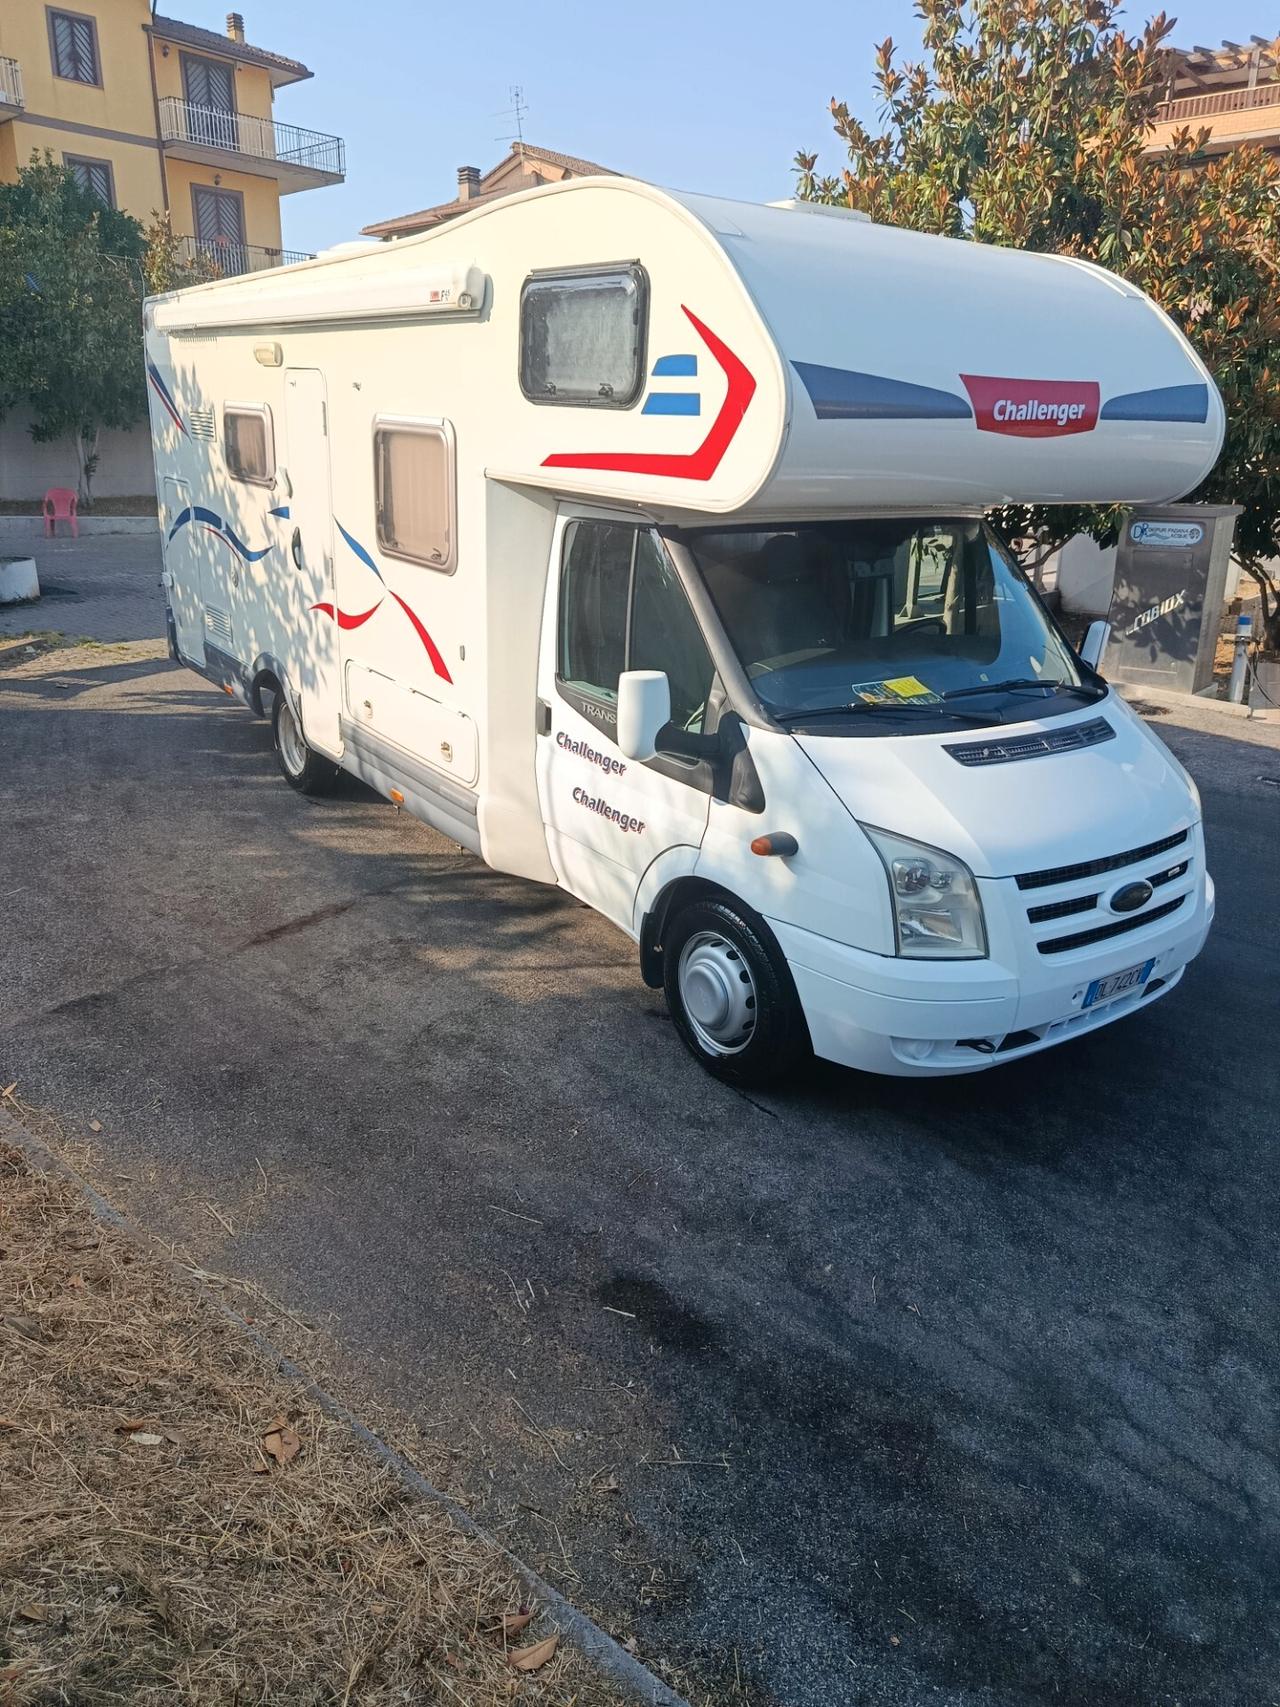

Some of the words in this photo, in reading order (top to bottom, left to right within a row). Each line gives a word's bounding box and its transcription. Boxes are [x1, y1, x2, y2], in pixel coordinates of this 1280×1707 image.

[993, 400, 1086, 426] Challenger
[581, 702, 617, 724] TRANS
[556, 731, 627, 776] Challenger
[572, 787, 646, 834] Challenger
